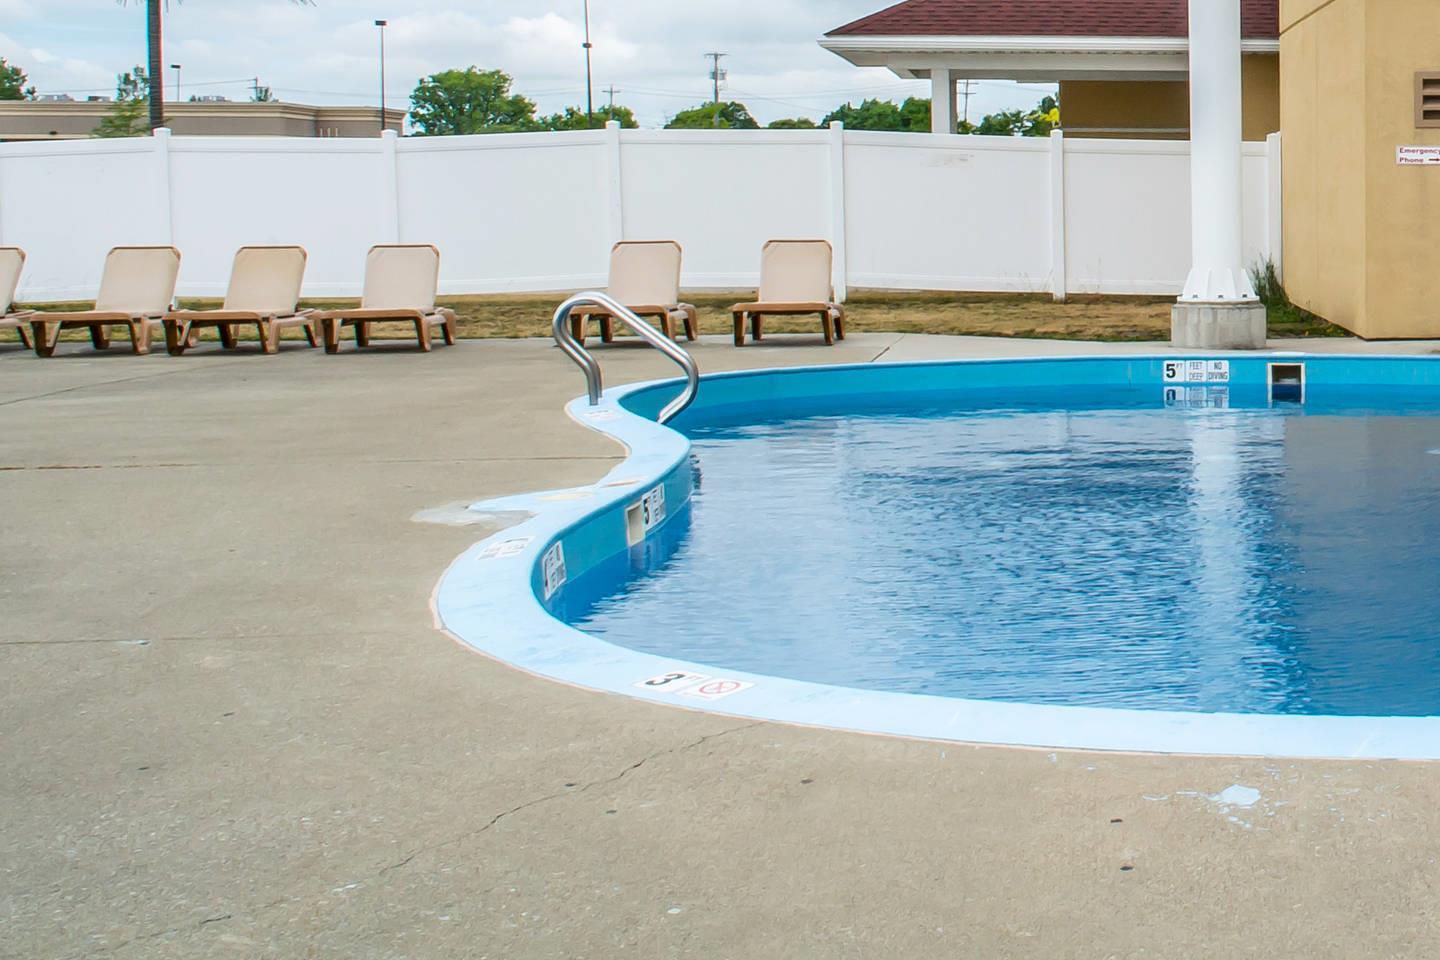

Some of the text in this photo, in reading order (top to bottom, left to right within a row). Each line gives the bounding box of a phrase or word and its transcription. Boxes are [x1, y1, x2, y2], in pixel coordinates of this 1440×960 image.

[1166, 363, 1176, 379] 5
[1213, 361, 1222, 371] NO
[1207, 371, 1228, 380] DIVING
[645, 673, 686, 686] 3
